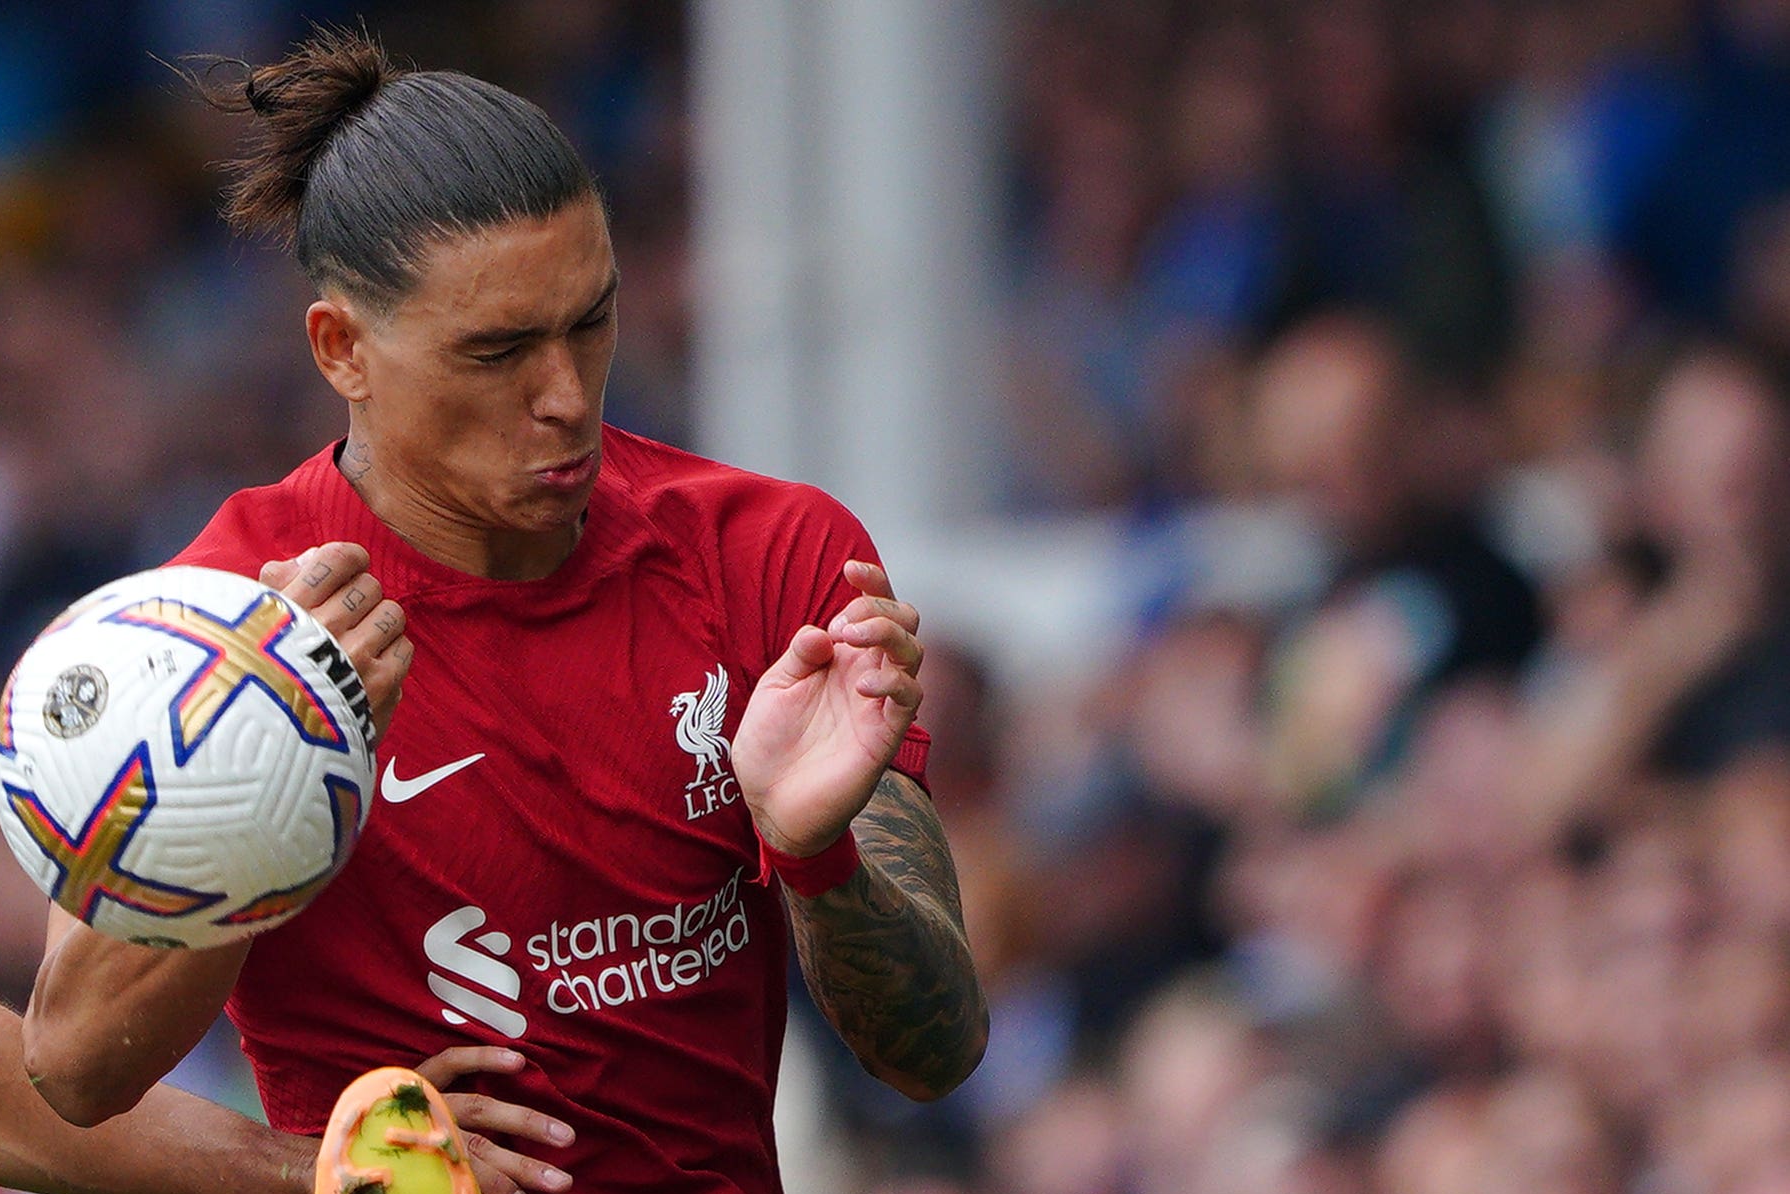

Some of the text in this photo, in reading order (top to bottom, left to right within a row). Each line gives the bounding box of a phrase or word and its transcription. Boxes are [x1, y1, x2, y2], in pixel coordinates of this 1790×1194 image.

[684, 778, 740, 821] L.F.C.
[527, 865, 745, 971] standard
[547, 900, 750, 1014] chartered
